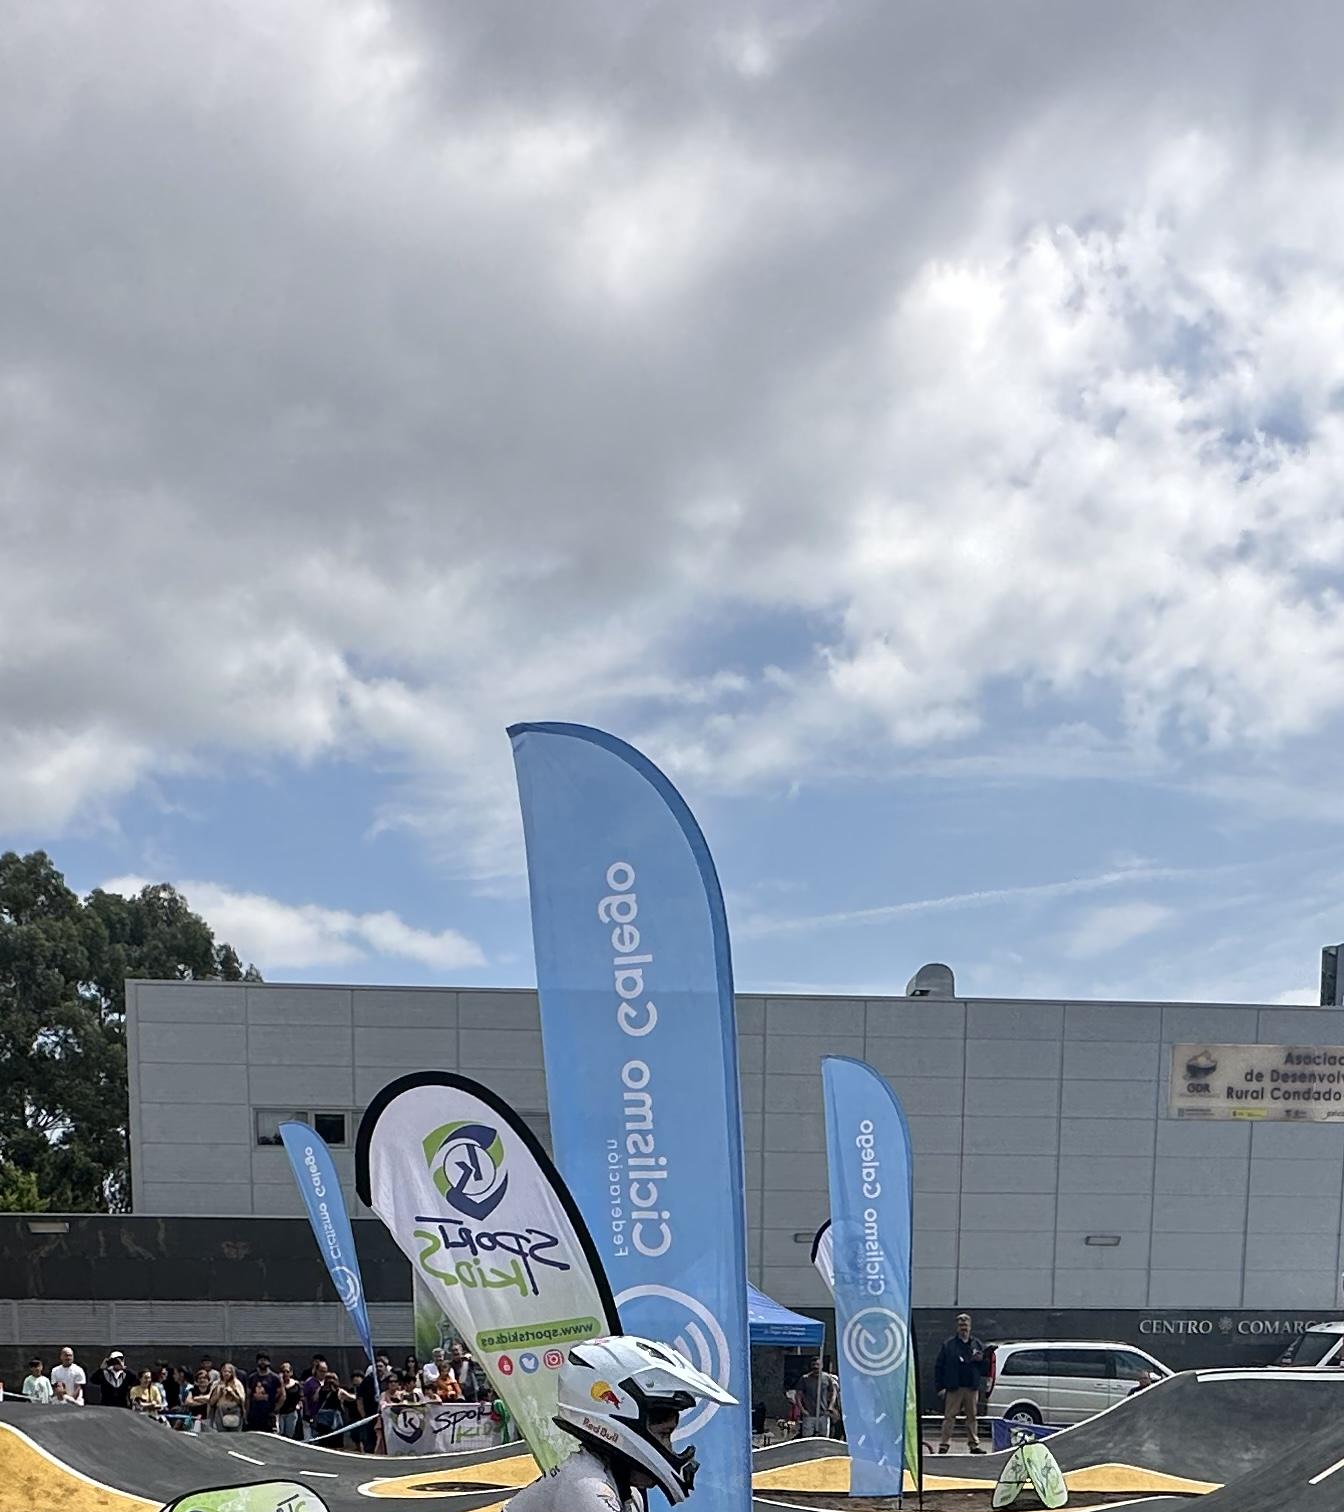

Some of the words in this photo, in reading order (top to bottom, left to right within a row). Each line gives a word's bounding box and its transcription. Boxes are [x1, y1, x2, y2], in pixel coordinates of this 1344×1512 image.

[1244, 1069, 1264, 1083] de
[1226, 1087, 1264, 1101] Rural
[1139, 1319, 1213, 1335] CENTRO
[582, 1417, 600, 1434] Red
[599, 1424, 619, 1443] Bull
